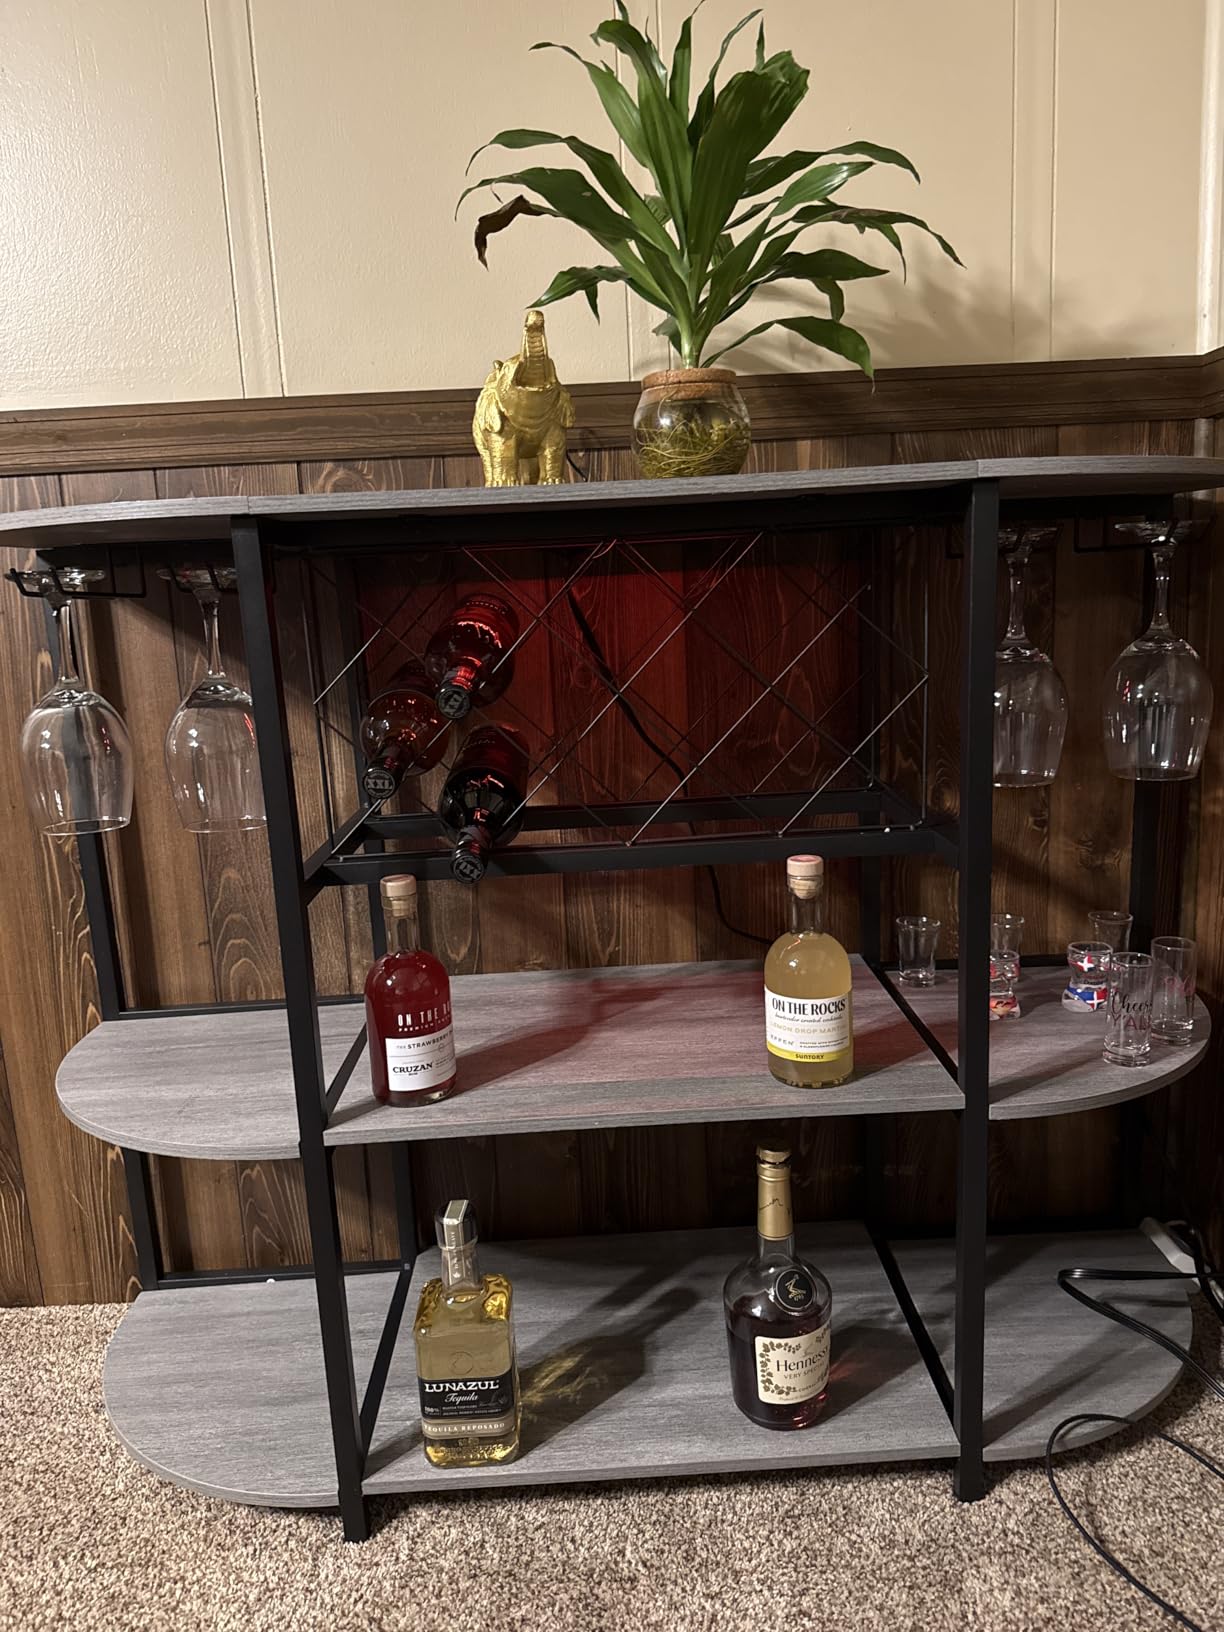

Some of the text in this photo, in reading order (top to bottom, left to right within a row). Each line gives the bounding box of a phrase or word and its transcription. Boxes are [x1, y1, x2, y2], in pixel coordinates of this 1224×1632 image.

[367, 778, 393, 788] XXL
[772, 998, 846, 1016] ON THE ROCKS
[398, 1013, 412, 1026] ON
[420, 1008, 438, 1023] THE
[393, 1063, 433, 1073] CRUZAN
[783, 1372, 802, 1380] VERY
[424, 1380, 499, 1392] LUNAZUL
[444, 1391, 479, 1405] Tequila
[424, 1424, 458, 1433] TEQUILA
[461, 1423, 505, 1432] REPOSADO
